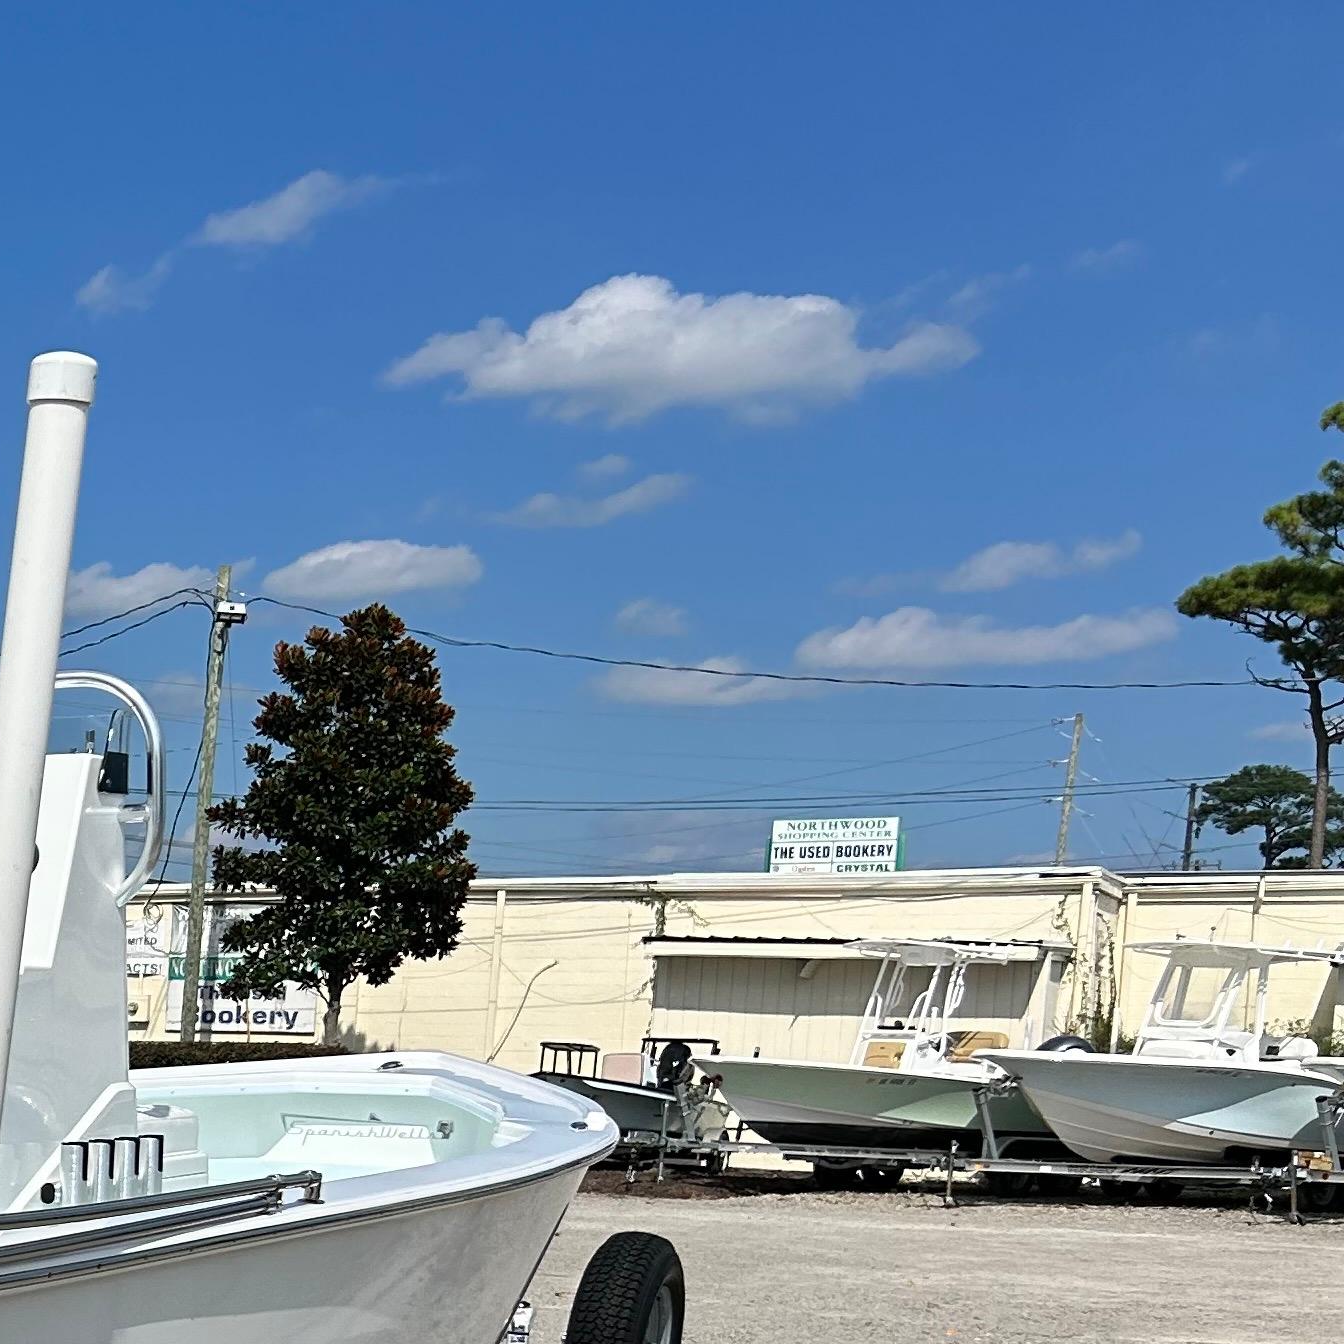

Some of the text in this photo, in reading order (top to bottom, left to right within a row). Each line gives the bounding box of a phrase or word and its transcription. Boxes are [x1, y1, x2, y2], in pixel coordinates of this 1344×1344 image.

[787, 819, 887, 831] NORTHWOOD
[777, 830, 892, 840] SHOPPING CENTER
[773, 846, 830, 859] THE USED
[835, 844, 893, 858] BOOKERY
[836, 864, 891, 872] CRYSTAL
[197, 1006, 299, 1030] ookery
